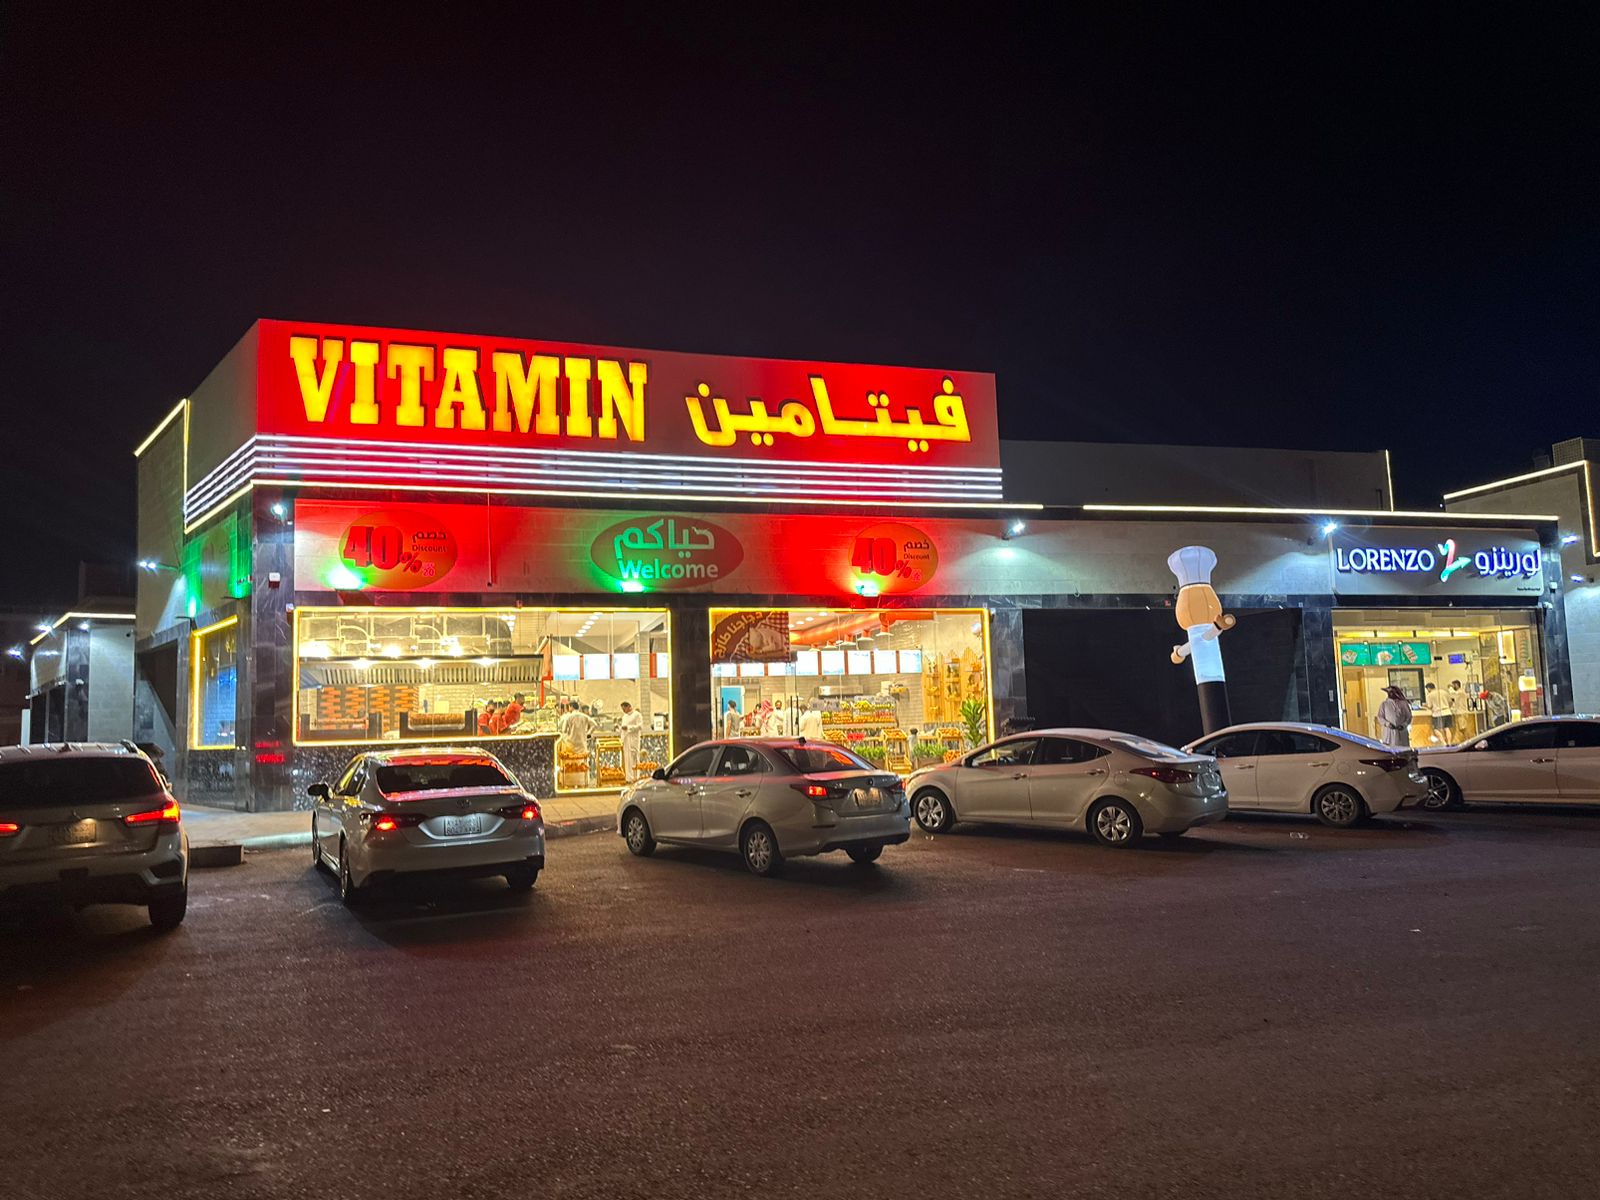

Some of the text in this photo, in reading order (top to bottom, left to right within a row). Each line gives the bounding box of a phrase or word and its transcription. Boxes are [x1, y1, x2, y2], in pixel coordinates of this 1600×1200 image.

[289, 336, 648, 442] VITAMIN
[685, 374, 972, 453] فيتامين
[412, 544, 448, 553] Discount
[613, 518, 716, 560] حياكم
[903, 539, 930, 552] خصم
[619, 558, 719, 580] Welcome
[1336, 547, 1435, 572] LORENZO
[1474, 547, 1542, 578] لورينزو
